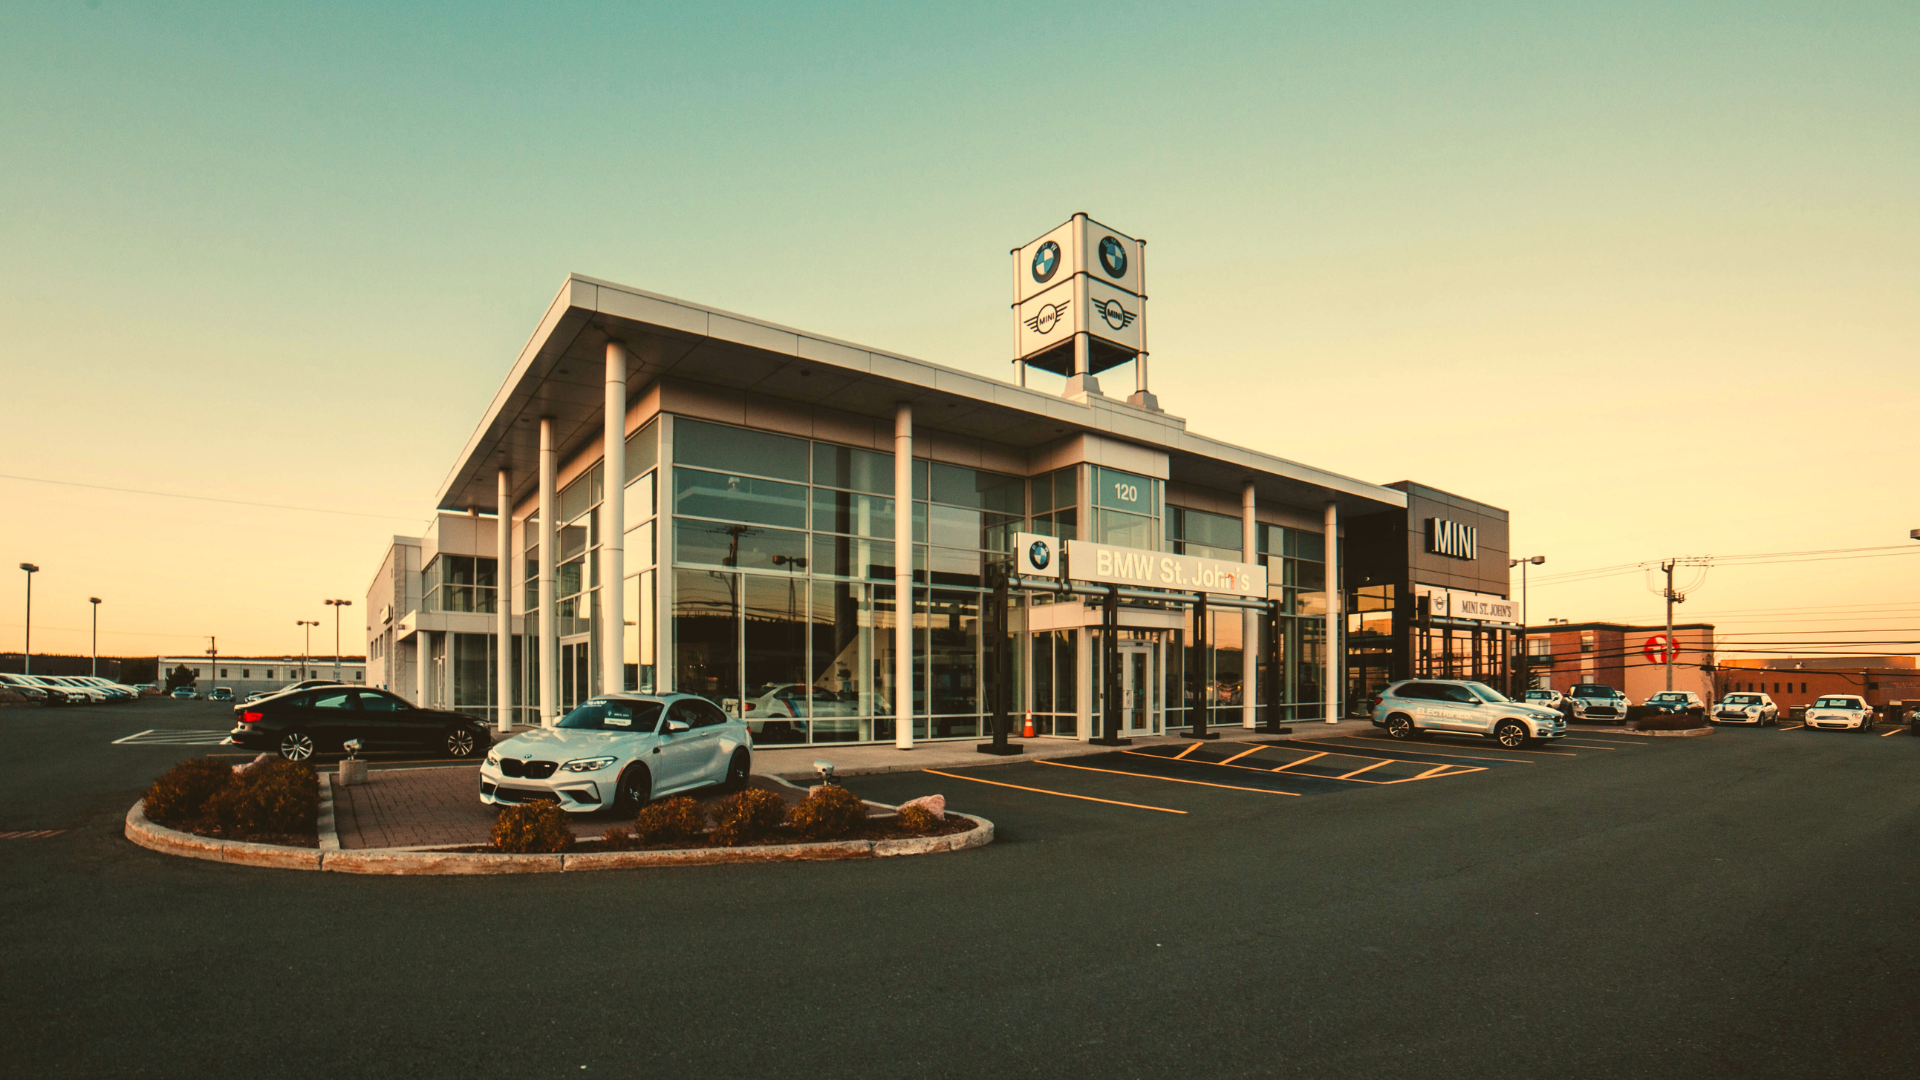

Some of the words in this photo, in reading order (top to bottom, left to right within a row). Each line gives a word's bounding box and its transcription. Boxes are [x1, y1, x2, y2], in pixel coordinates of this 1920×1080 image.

[1039, 312, 1055, 326] MINI
[1107, 309, 1123, 322] MINI
[1114, 482, 1138, 502] 120
[1433, 517, 1477, 560] MINI
[1096, 549, 1154, 581] BMW
[1160, 557, 1187, 585] St.
[1191, 562, 1250, 592] John's
[1461, 600, 1478, 614] MINI
[1480, 602, 1489, 615] ST.
[1490, 604, 1511, 618] JOHN'S
